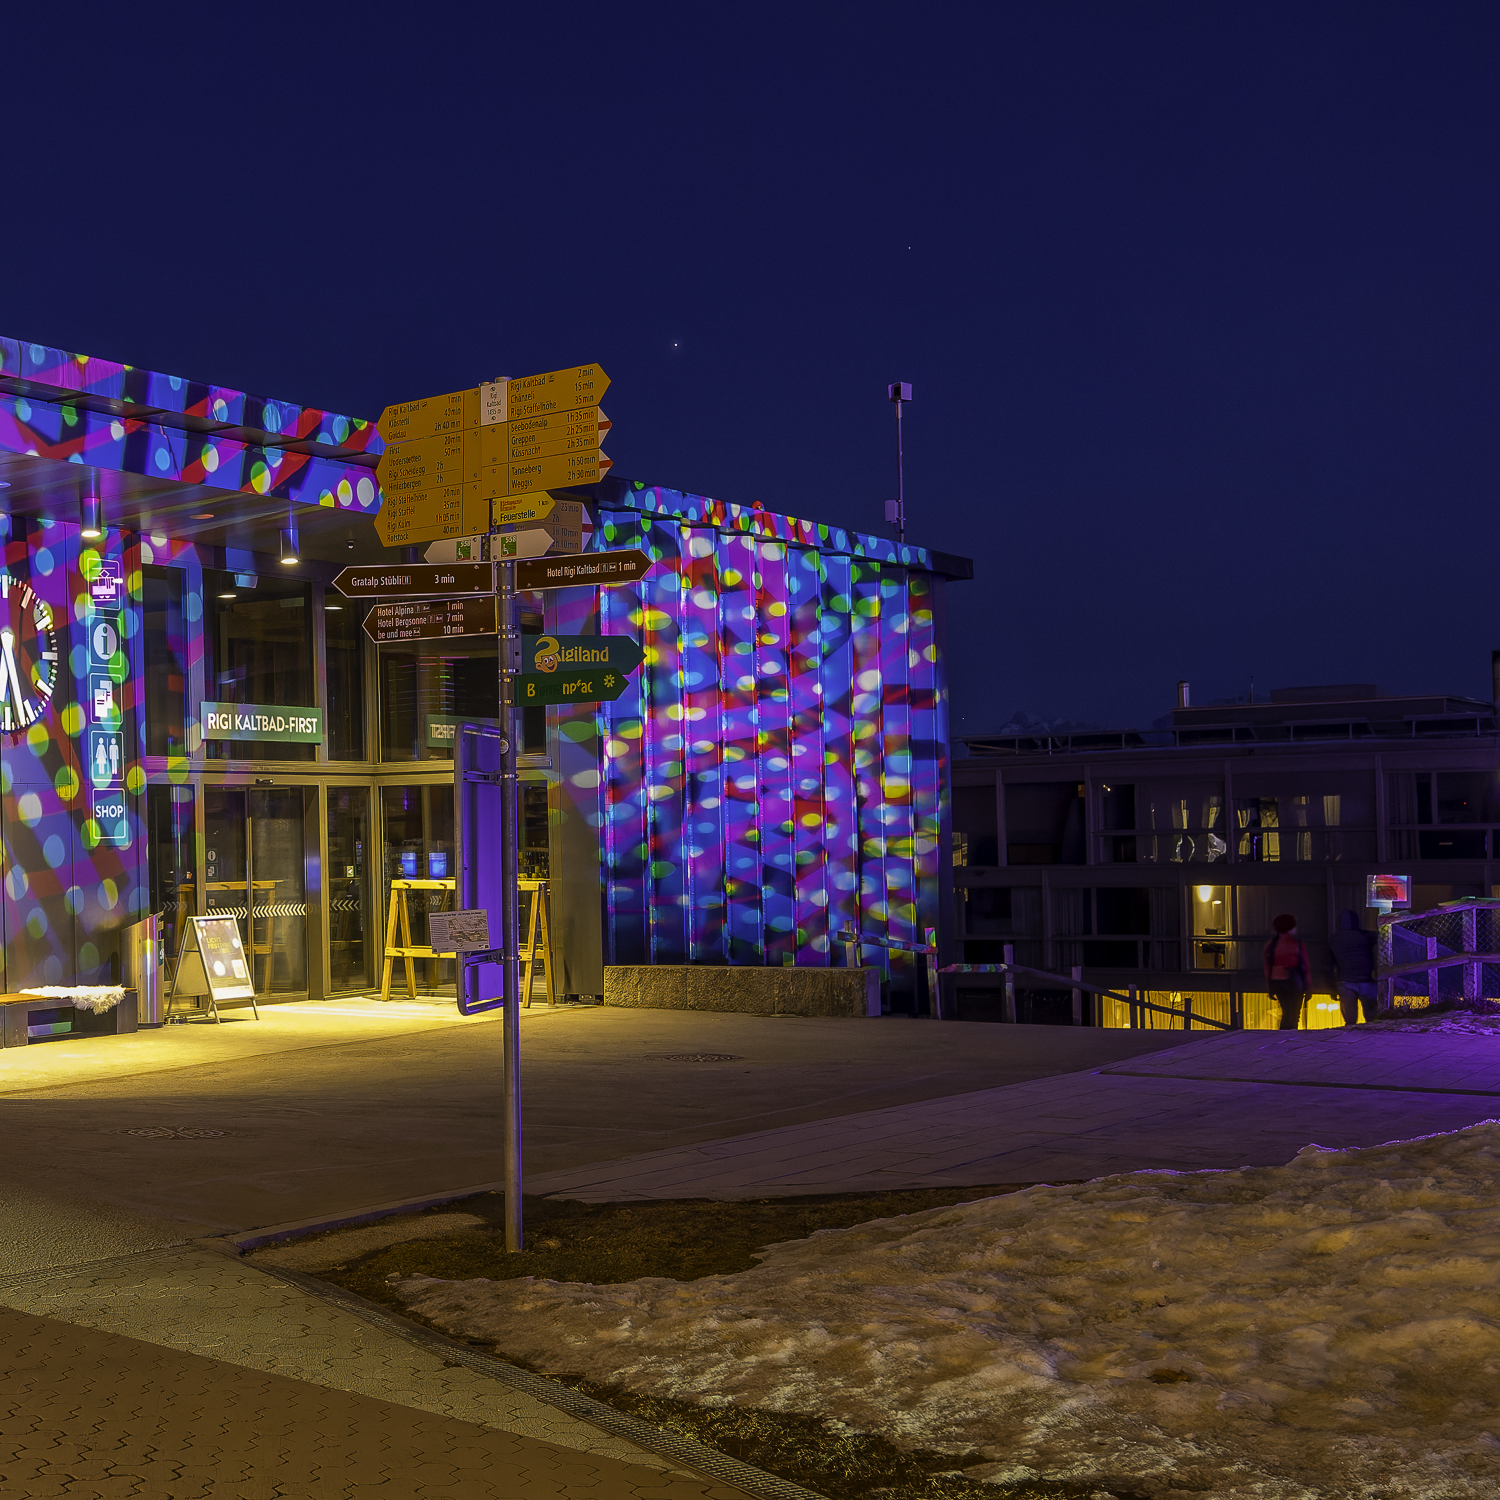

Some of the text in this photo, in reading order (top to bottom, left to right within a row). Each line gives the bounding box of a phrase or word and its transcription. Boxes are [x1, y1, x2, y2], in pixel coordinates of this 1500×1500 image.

[511, 381, 522, 393] Rigi
[523, 376, 545, 388] Kaltbad
[389, 407, 398, 417] Rigi
[512, 419, 548, 433] Seebodenalp
[389, 430, 406, 440] Goldau
[512, 434, 536, 447] Greppen
[512, 446, 541, 458] Küssnacht
[389, 470, 398, 480] Rigi
[512, 465, 542, 476] Tanneberg
[389, 480, 422, 492] Hinterbergen
[512, 479, 533, 490] Weggis
[388, 497, 398, 508] Rigi
[388, 509, 397, 520] Rigi
[501, 509, 536, 522] Feuerstelle
[547, 566, 563, 578] Hotel
[564, 566, 576, 578] Rigi
[577, 564, 600, 576] Kaltbad
[624, 561, 636, 571] min
[352, 574, 455, 588] Gratalp Stübli 3 min
[377, 607, 394, 617] Hotel
[395, 605, 414, 618] Alpina
[452, 602, 464, 610] min
[377, 618, 394, 628] Hotel
[395, 617, 427, 628] Bergsonne
[452, 613, 464, 622] min
[378, 630, 386, 640] be
[387, 629, 398, 639] und
[443, 626, 451, 634] 10
[452, 625, 464, 634] min
[207, 713, 318, 734] RIGI KALTBAD-FIRST
[95, 805, 124, 818] SHOP
